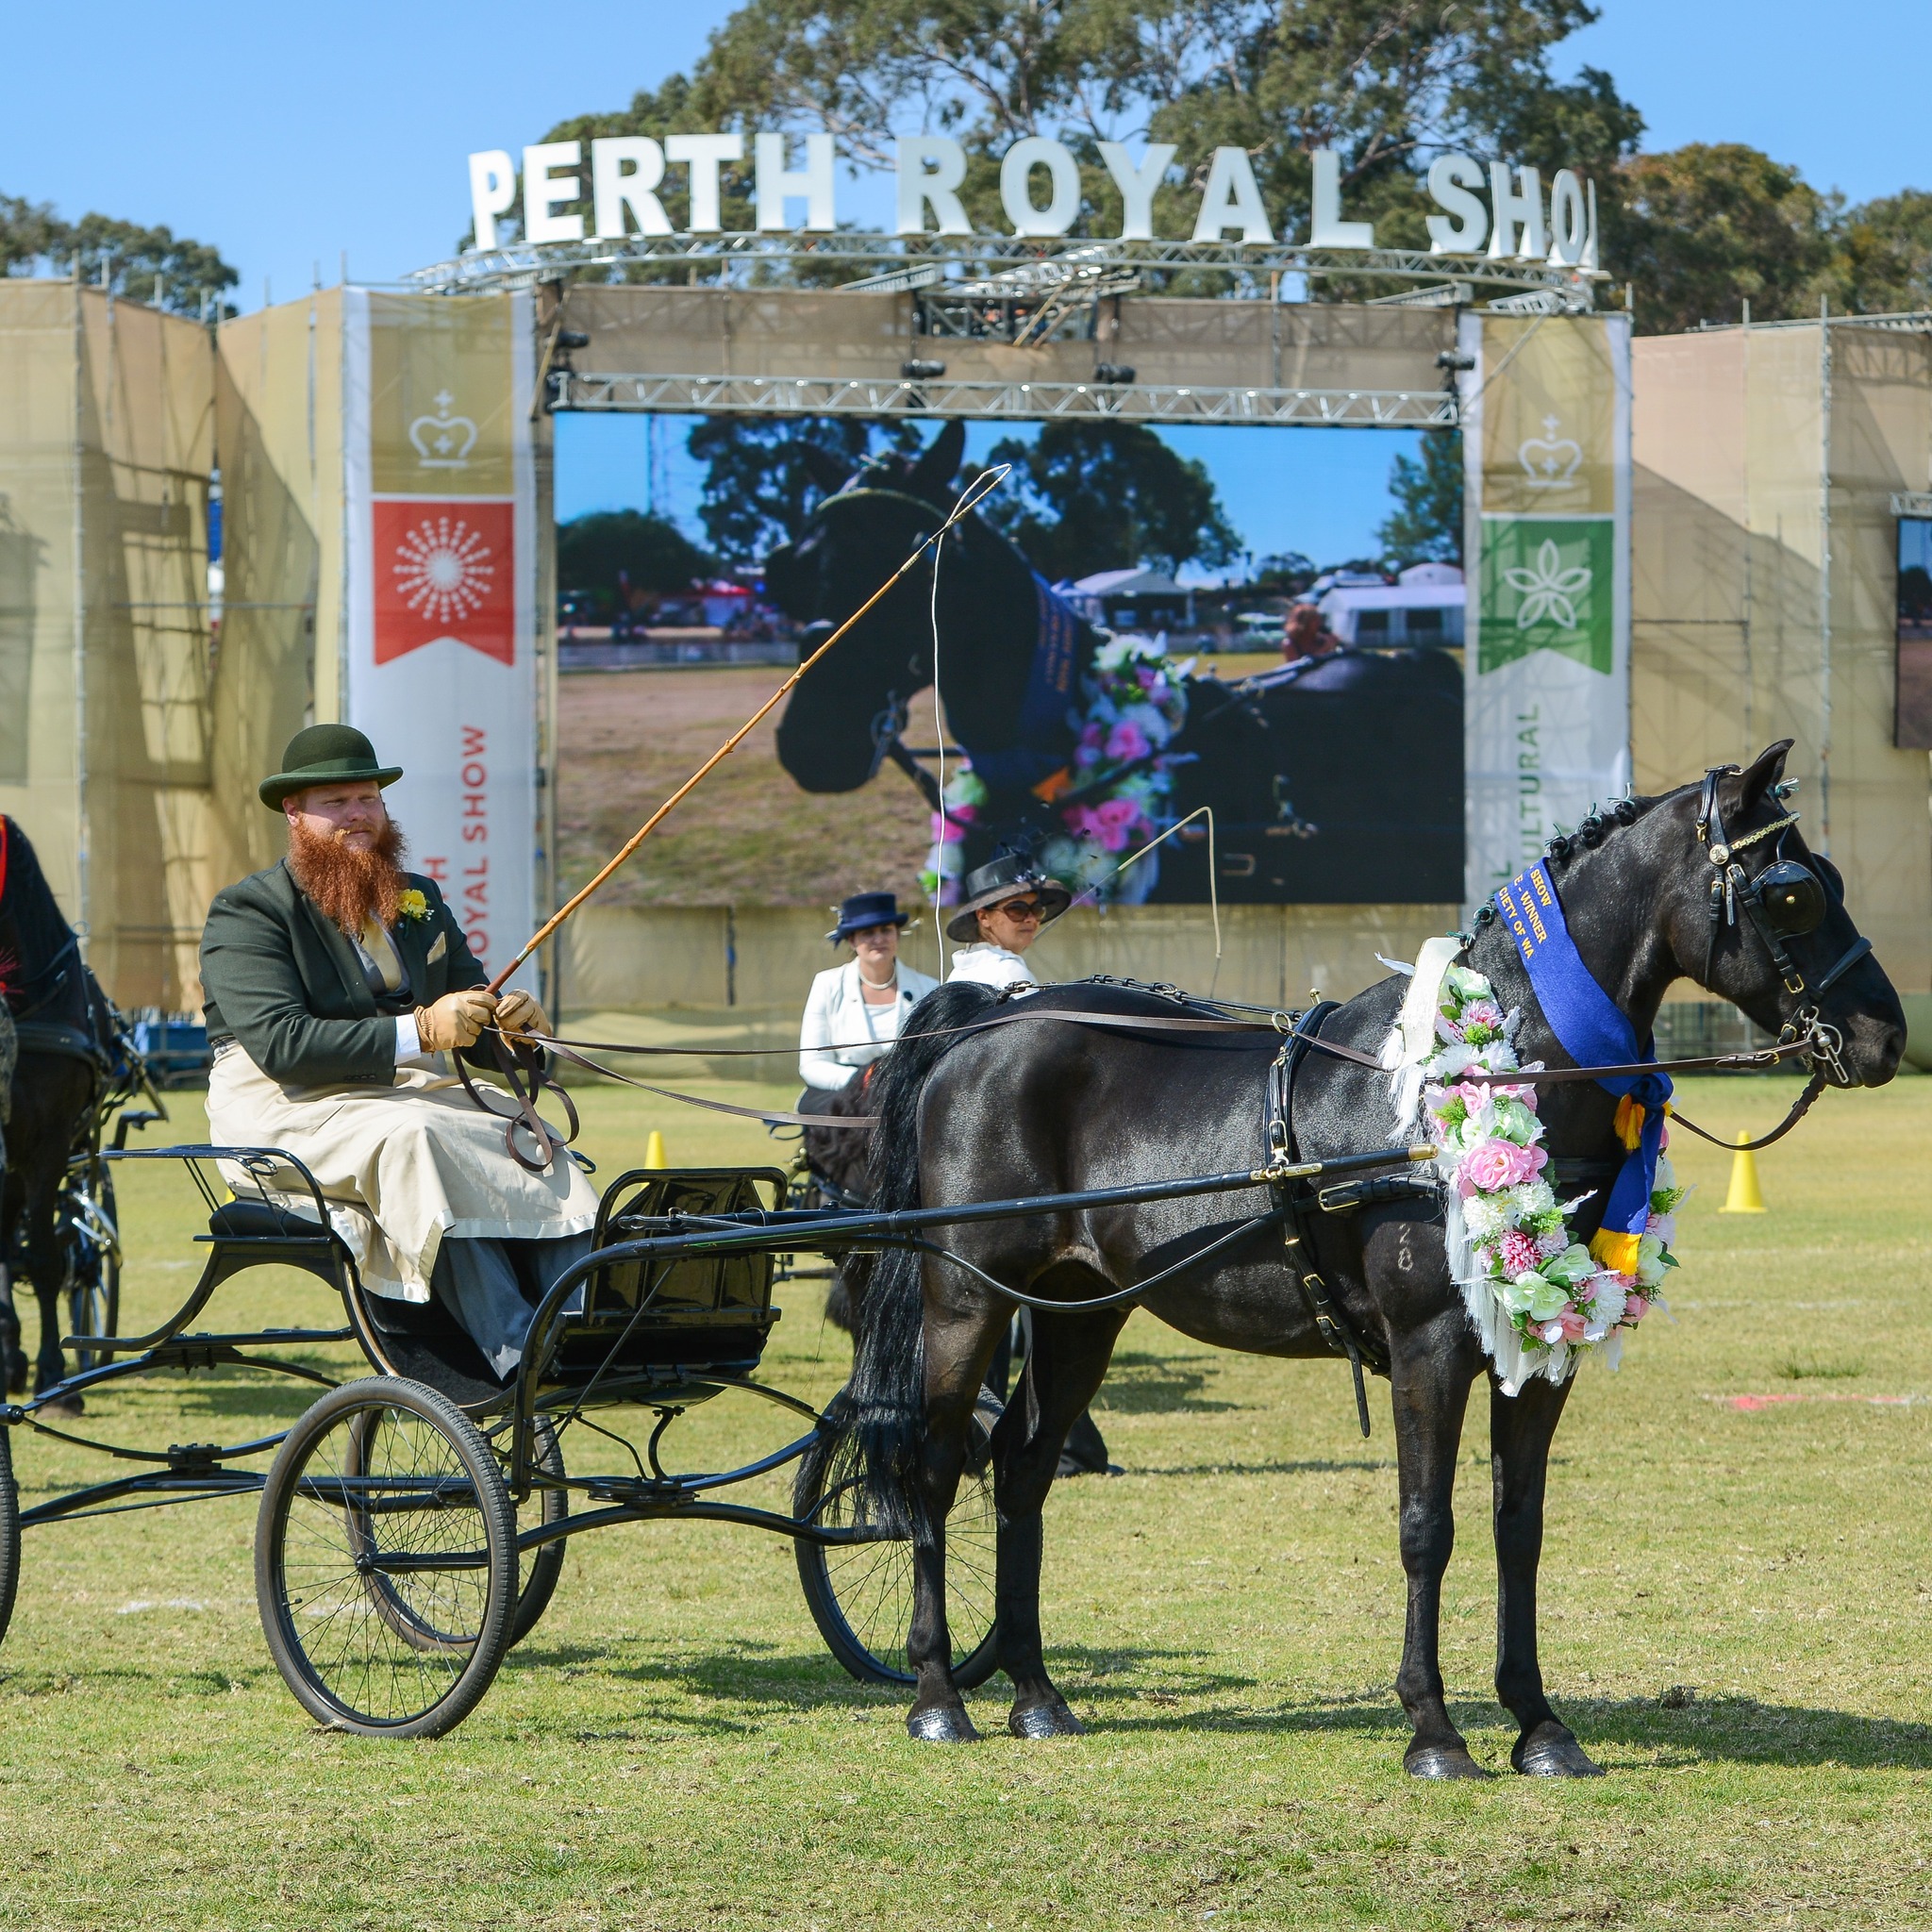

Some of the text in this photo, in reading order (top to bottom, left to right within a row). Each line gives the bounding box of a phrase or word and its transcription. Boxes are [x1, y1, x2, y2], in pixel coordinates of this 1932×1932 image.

[468, 132, 1599, 271] PERTH ROYAL SHO
[1517, 704, 1542, 870] ULTURAL
[460, 724, 489, 969] OYAL SHOW
[1530, 868, 1552, 907] SHOW
[1498, 886, 1518, 919] CIETY
[1513, 920, 1526, 936] OF
[1522, 937, 1535, 959] WA
[1520, 891, 1547, 944] WINNER
